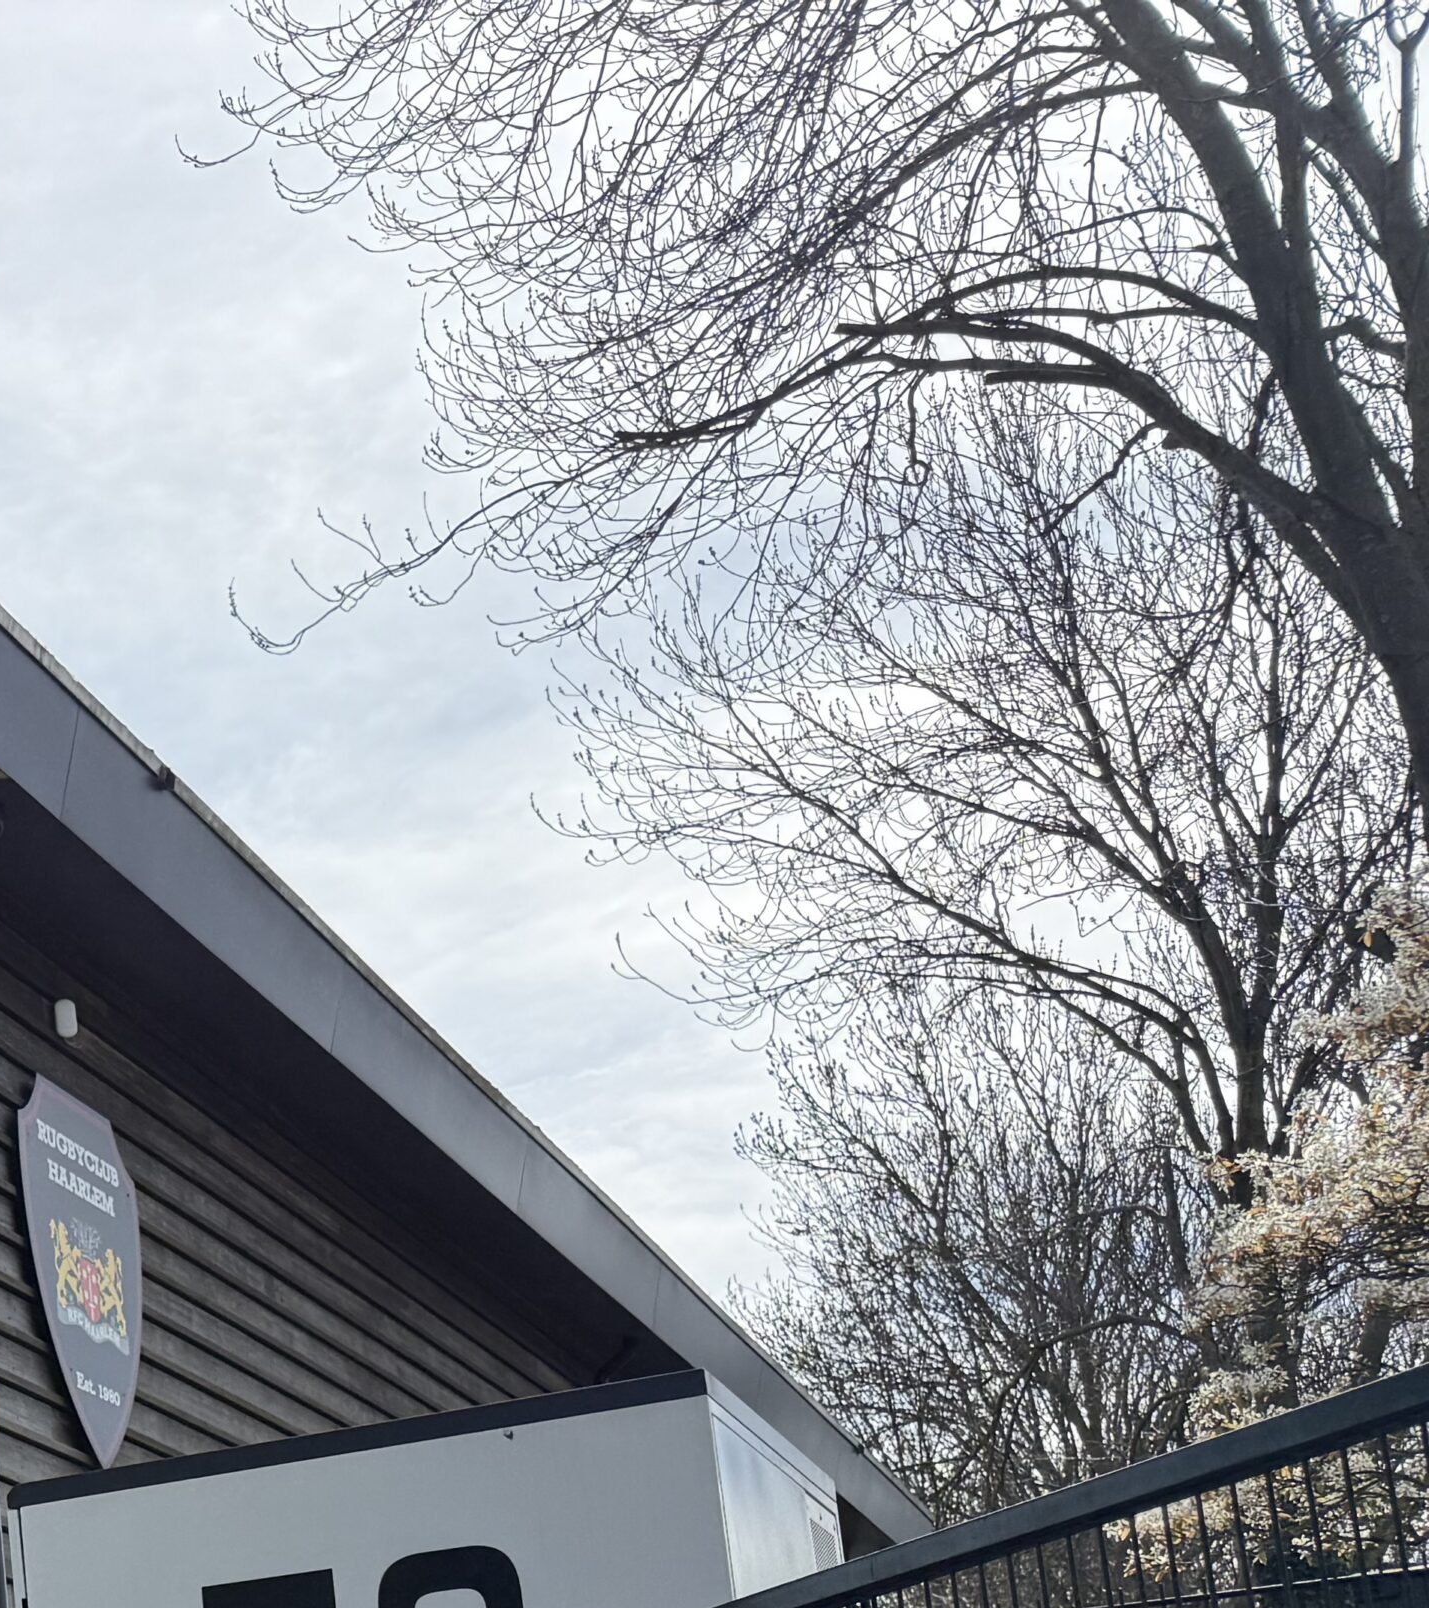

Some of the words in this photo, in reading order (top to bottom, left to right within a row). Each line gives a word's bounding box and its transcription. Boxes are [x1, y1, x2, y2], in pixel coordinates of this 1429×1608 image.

[36, 1118, 119, 1187] RUGBYCLUB
[47, 1158, 116, 1218] HAARLEM
[75, 1371, 96, 1396] Est.
[98, 1384, 121, 1407] 1980
